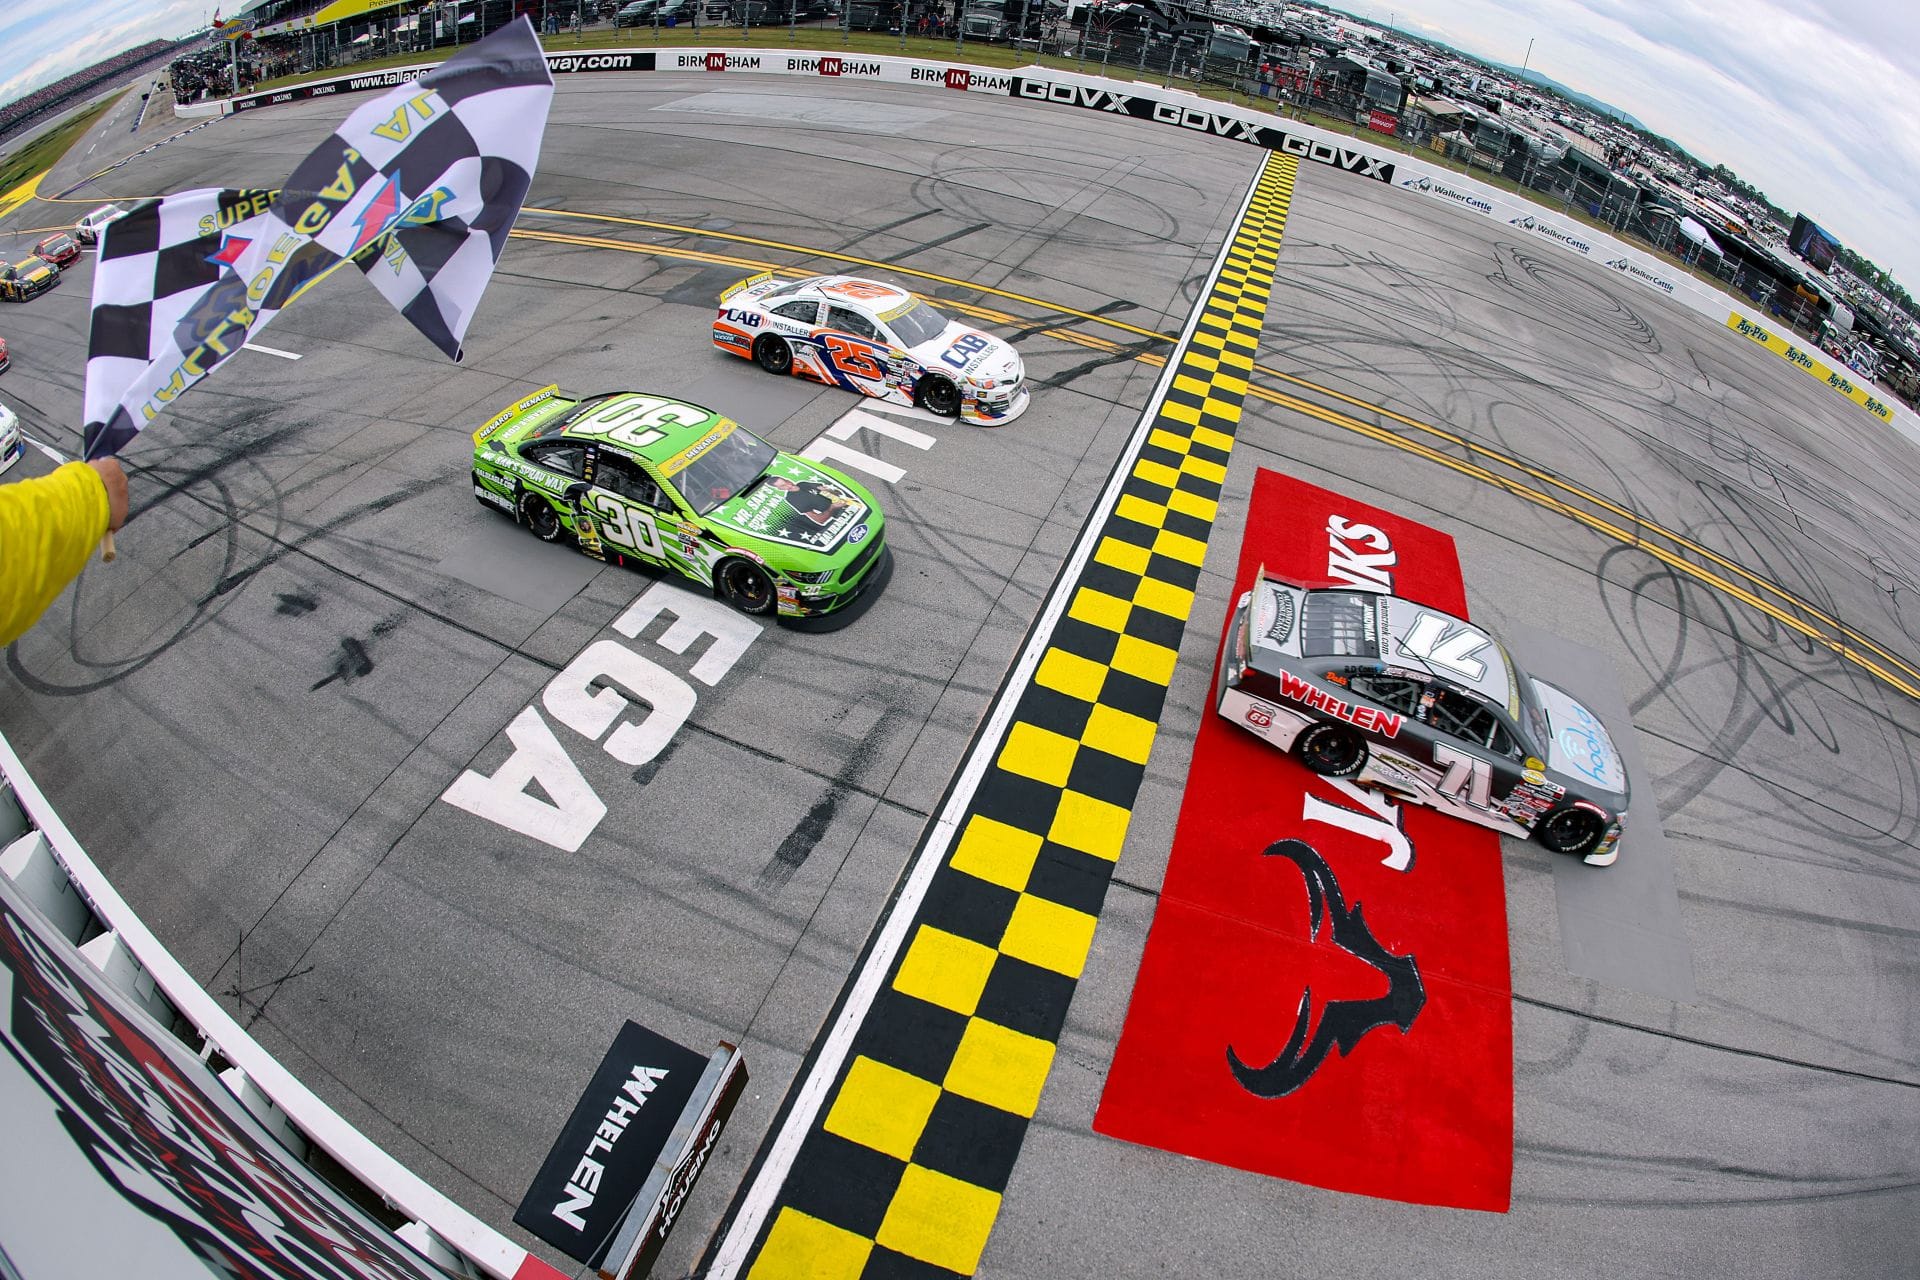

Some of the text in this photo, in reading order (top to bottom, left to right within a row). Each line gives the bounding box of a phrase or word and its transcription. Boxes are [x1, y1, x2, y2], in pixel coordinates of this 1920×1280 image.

[678, 54, 760, 70] BIRMINGHAM
[787, 58, 881, 76] BIRMINGHAM
[910, 67, 1011, 91] BIRMINGHAM
[1019, 77, 1133, 116] GOVX
[1153, 101, 1264, 145] GOVX
[1281, 133, 1387, 181] GOVX
[726, 308, 762, 328] CAB
[825, 335, 883, 381] 25
[941, 334, 989, 369] CAB
[964, 344, 1000, 376] INSTALLERS
[518, 390, 556, 411] MENARDS
[479, 411, 514, 440] MENARDS
[571, 396, 712, 448] 30
[685, 432, 722, 460] MENARDS
[519, 463, 546, 483] SPRAY
[544, 475, 567, 493] WAX
[732, 508, 754, 526] MR.
[747, 485, 774, 510] SAM'S
[748, 508, 772, 531] SPRAY
[596, 495, 666, 560] 30
[850, 526, 868, 543] Ford
[1270, 591, 1286, 640] CONSULTANTS
[1278, 592, 1295, 642] AUTOMOTIVE
[1363, 603, 1376, 642] JANKOWIAK
[1248, 712, 1271, 726] 66
[1279, 668, 1402, 739] WHELEN
[1433, 740, 1493, 810] 71
[551, 1064, 670, 1232] WHELEN
[659, 1118, 722, 1239] HOUSING
